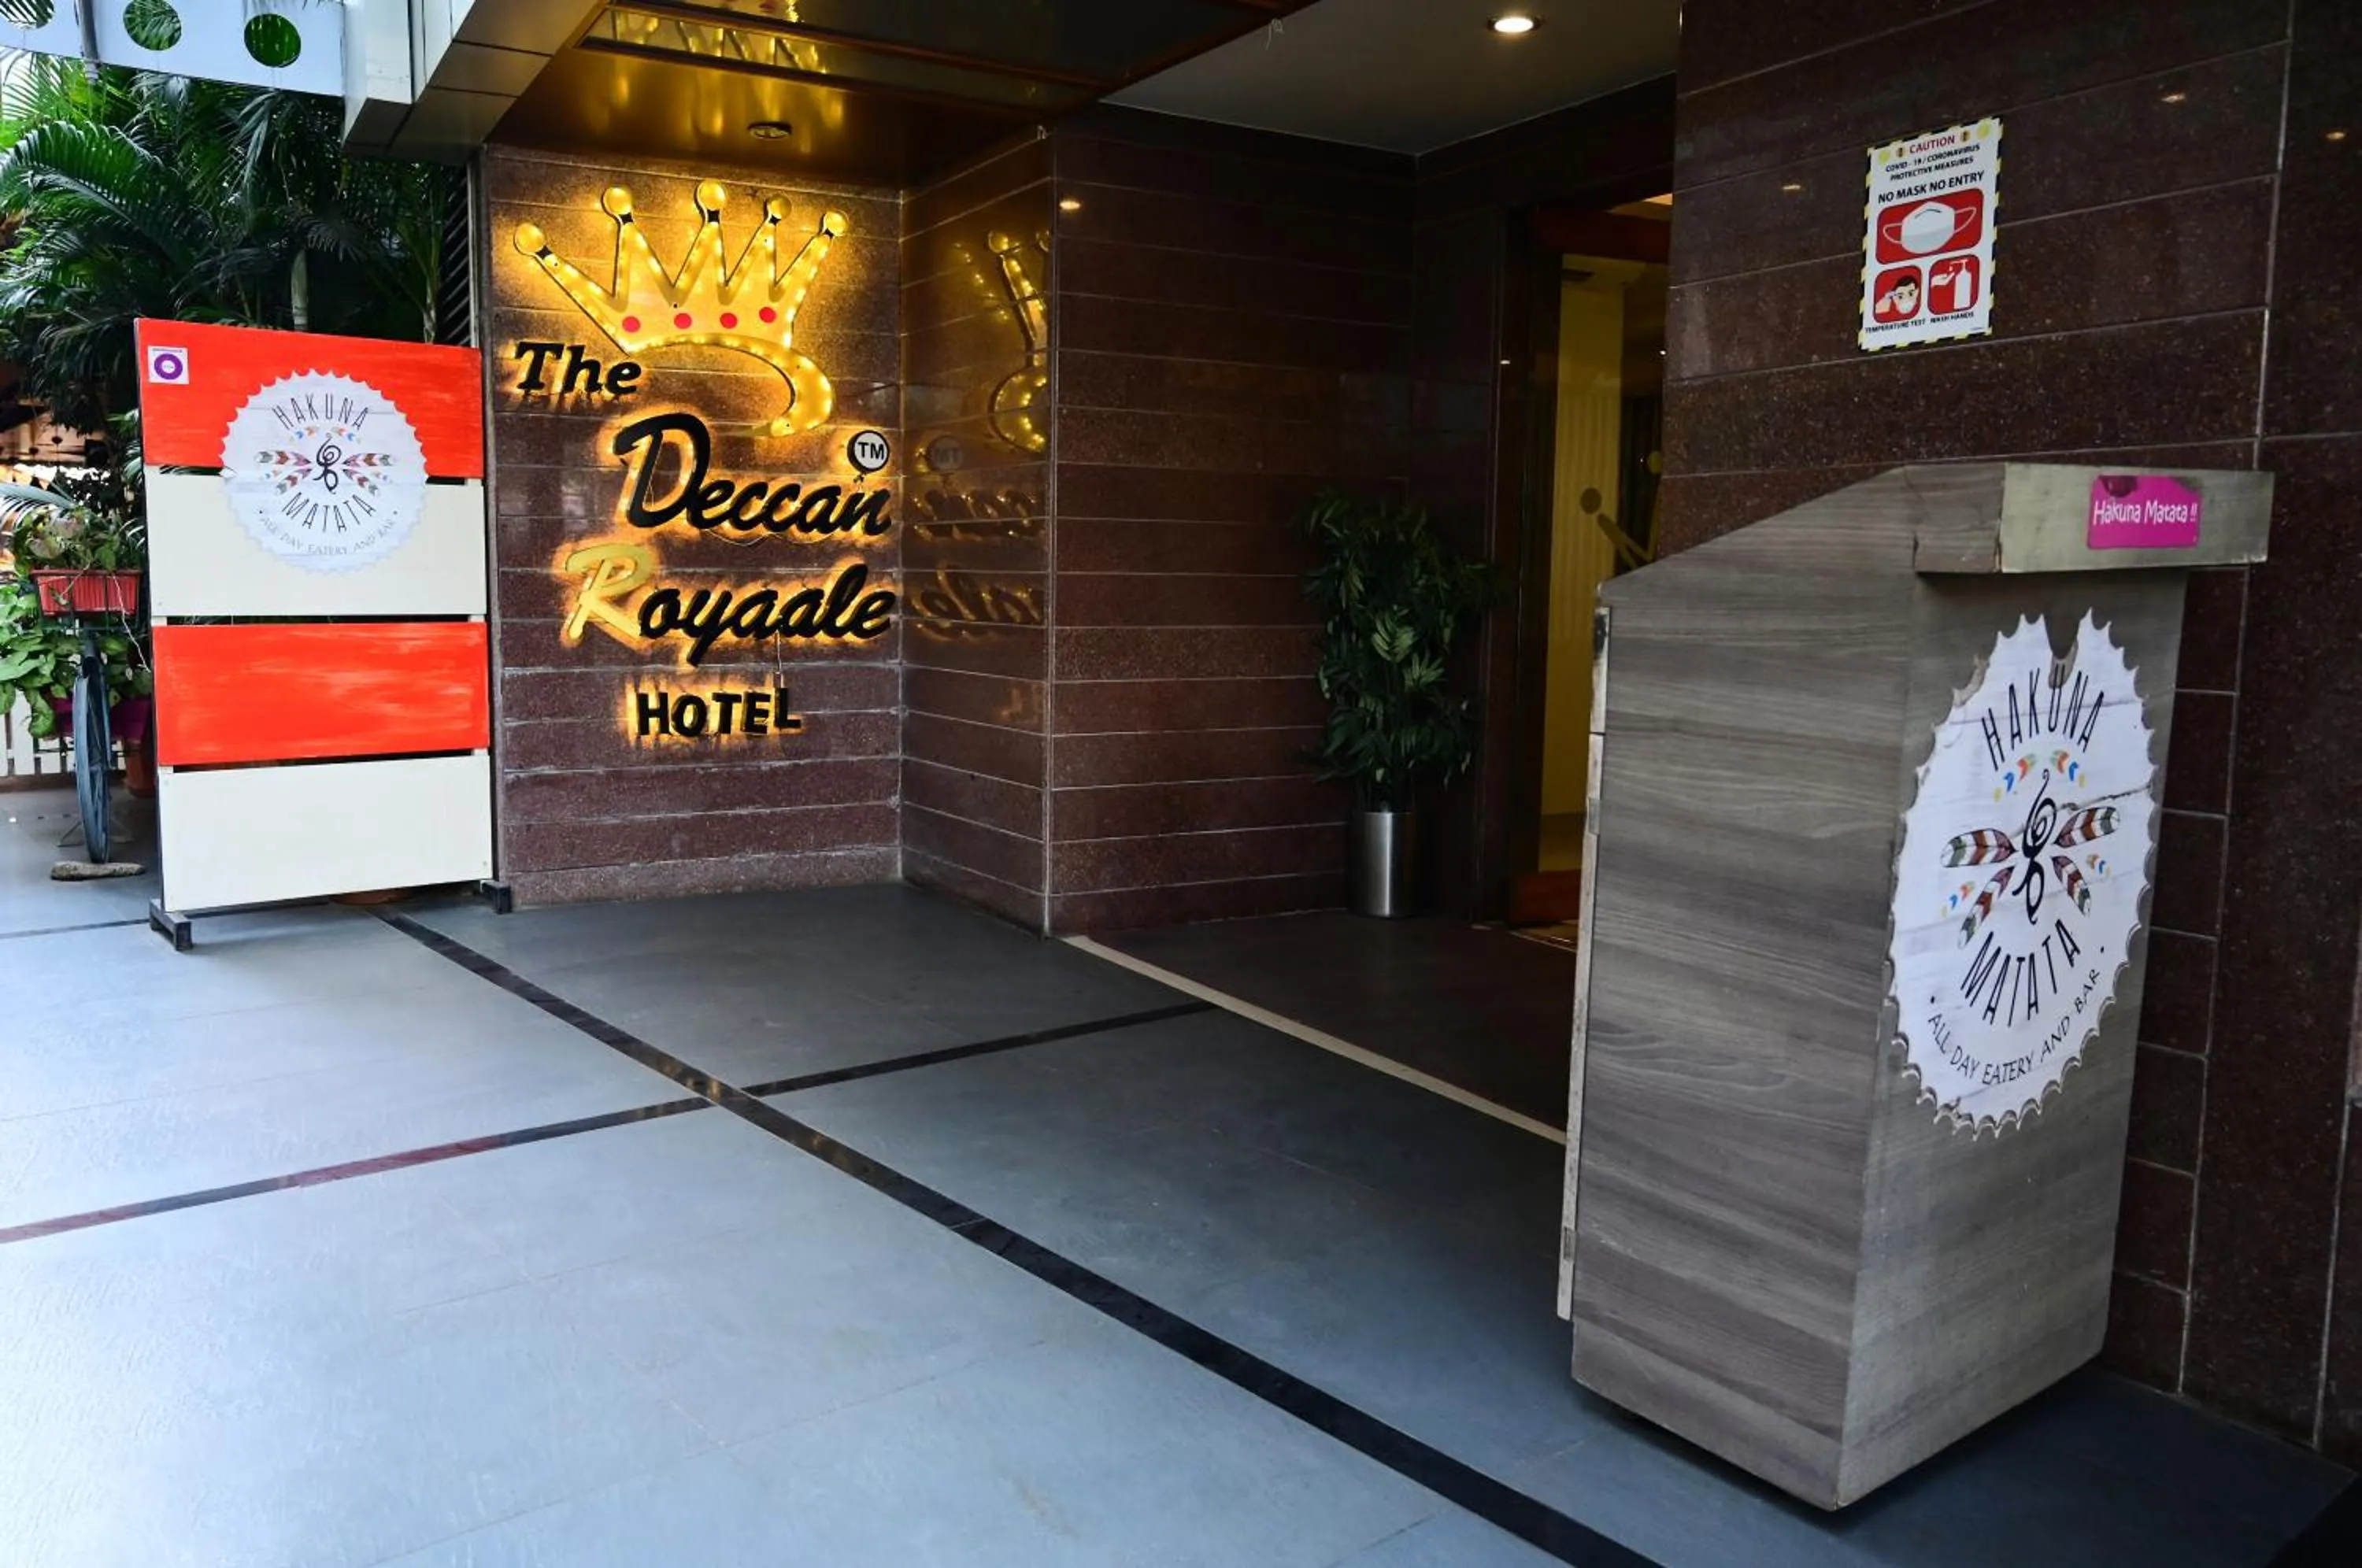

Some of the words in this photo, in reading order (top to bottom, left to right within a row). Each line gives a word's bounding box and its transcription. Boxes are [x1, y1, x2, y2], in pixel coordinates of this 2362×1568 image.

[1909, 135, 1955, 153] CAUTION
[1886, 161, 1907, 172] COVID
[1890, 166, 1932, 181] PROTECTIVE
[1934, 156, 1974, 171] MEASURES
[1878, 191, 1894, 204] NO
[1896, 183, 1927, 199] MASK
[1929, 179, 1946, 190] NO
[1949, 170, 1984, 188] ENTRY
[1911, 318, 1926, 327] TEST
[516, 342, 642, 394] The
[272, 393, 368, 430] HAKUNA
[857, 442, 884, 460] TM
[613, 413, 892, 536] Deccan
[281, 492, 376, 533] MATATA
[2093, 497, 2142, 526] Hakuna
[280, 533, 302, 549] DAY
[308, 543, 347, 555] EATERY
[354, 534, 376, 552] AND
[564, 543, 897, 668] Royaale
[636, 687, 802, 737] HOTEL
[1981, 666, 2105, 771] HAKUNA
[1960, 918, 2081, 1027] MATATA
[1928, 1013, 1950, 1054] ALL
[1950, 1045, 1980, 1079] DAY
[1982, 1051, 2034, 1085] EATERY
[2040, 1015, 2071, 1062] AND
[2074, 969, 2101, 1014] BAR
